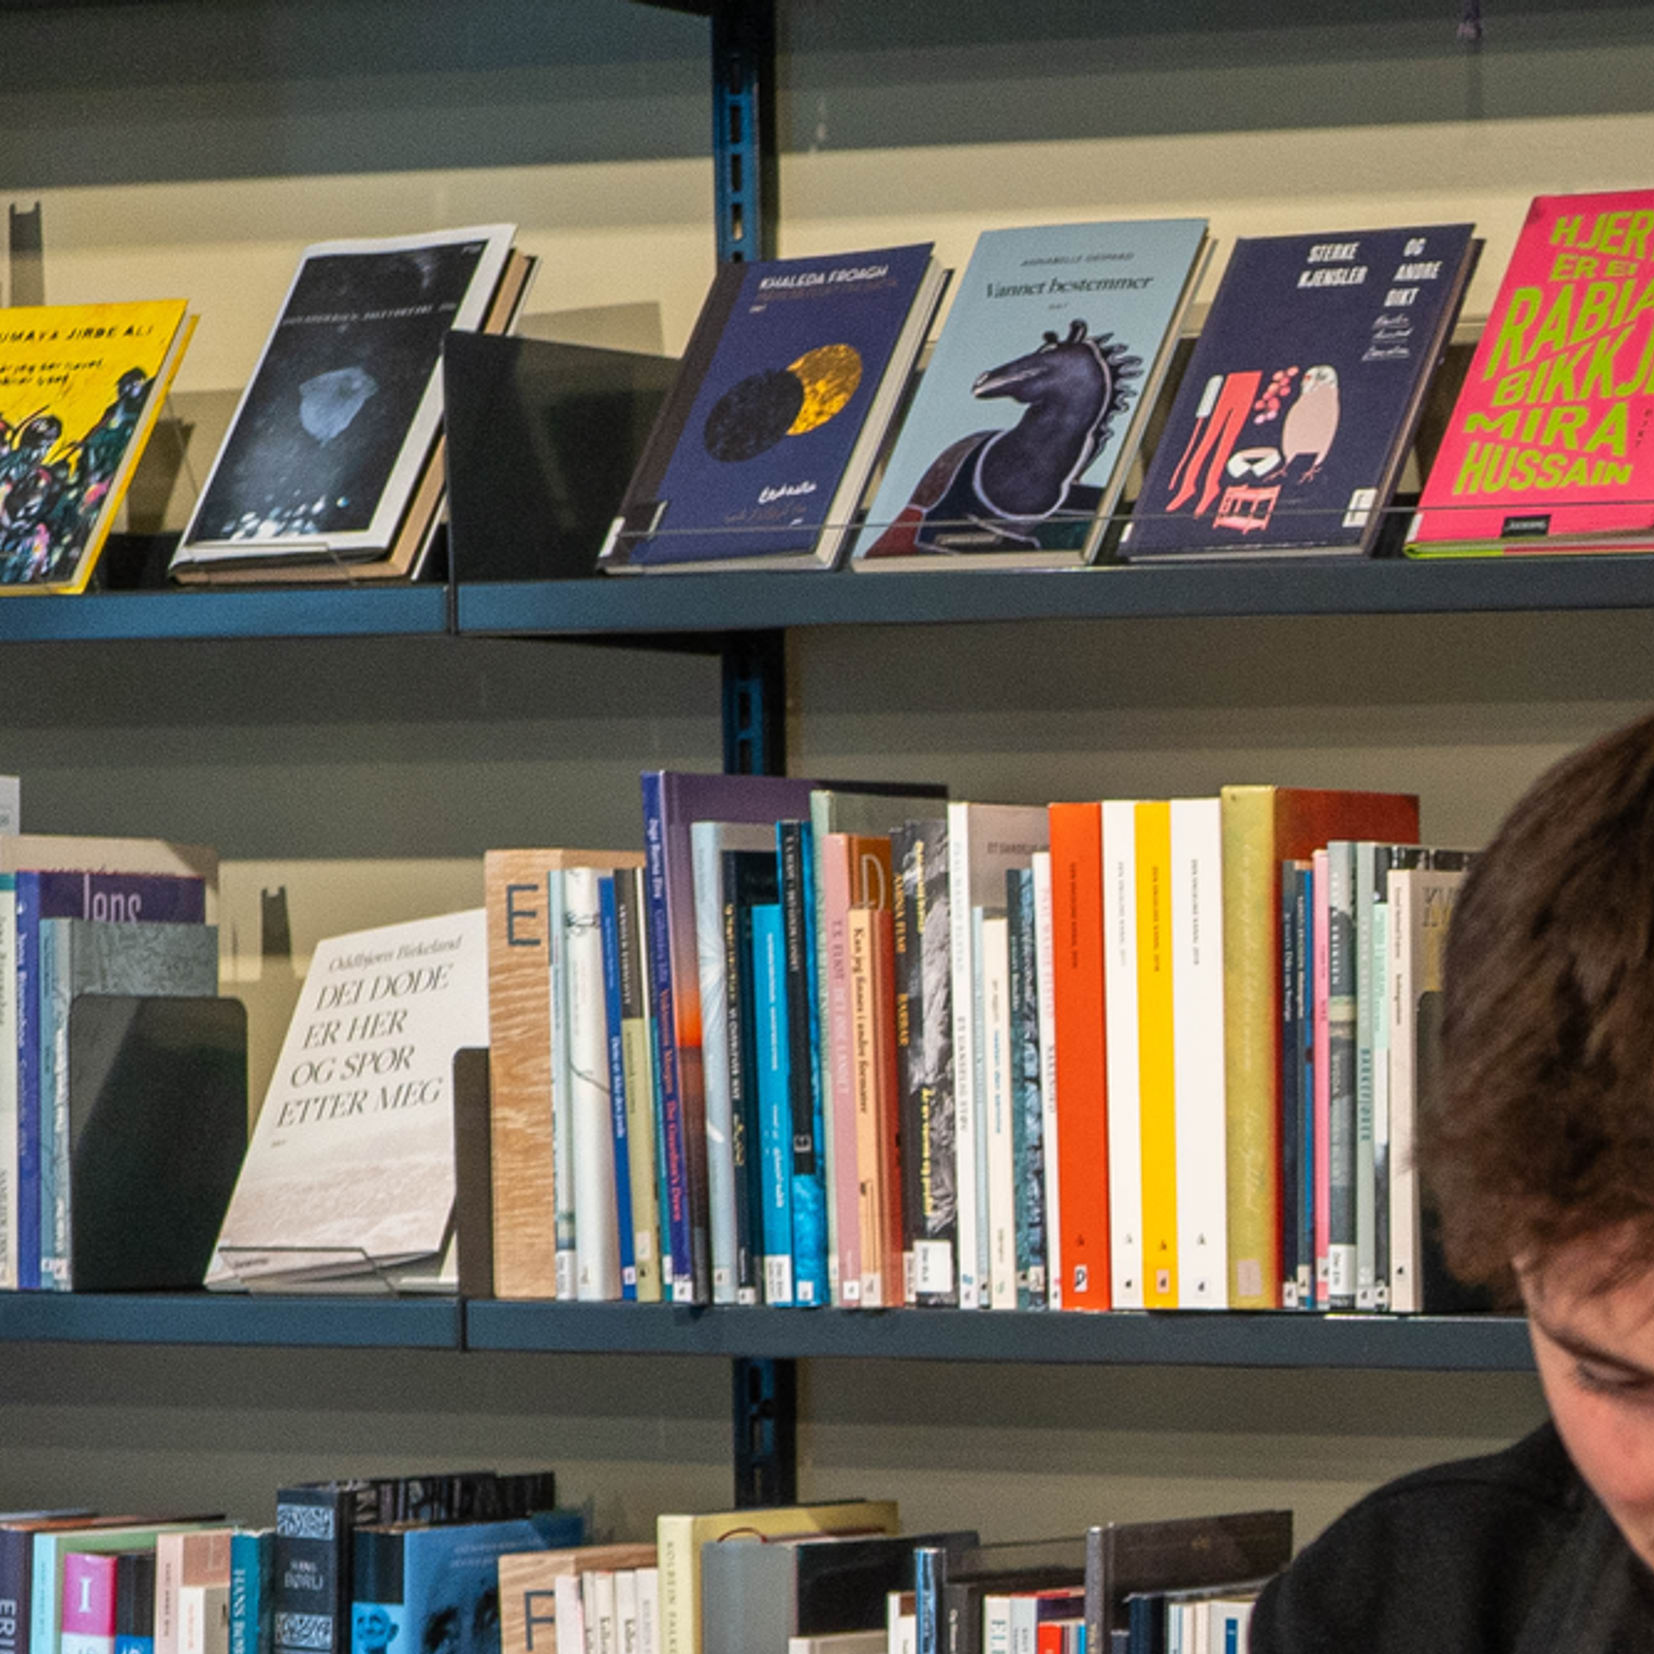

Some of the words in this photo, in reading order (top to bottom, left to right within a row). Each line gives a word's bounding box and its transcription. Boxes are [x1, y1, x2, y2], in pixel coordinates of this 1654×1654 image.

[1307, 241, 1360, 264] STERKE
[1403, 237, 1427, 258] OG
[1550, 254, 1603, 284] ER
[1611, 256, 1639, 277] EI
[1046, 275, 1155, 297] bestemmer
[1297, 265, 1369, 289] KJENSLER
[1393, 260, 1444, 282] ANDRE
[1384, 287, 1421, 308] DIKT
[1463, 402, 1631, 458] MIRA
[1453, 439, 1633, 496] HUSSAIN
[506, 883, 542, 948] E
[854, 927, 866, 954] Kan
[851, 956, 866, 975] jeg
[314, 977, 368, 1012] DEI
[368, 962, 455, 1000] DØDE
[855, 976, 868, 1013] finnes
[302, 1020, 342, 1050] ER
[347, 1008, 409, 1041] HER
[856, 1022, 868, 1058] andre
[290, 1061, 335, 1089] OG
[337, 1045, 416, 1081] SPOR
[858, 1059, 870, 1114] formater
[275, 1087, 369, 1129] ETTER
[374, 1077, 444, 1116] MEG
[232, 1569, 247, 1617] HANS
[524, 1590, 555, 1652] F
